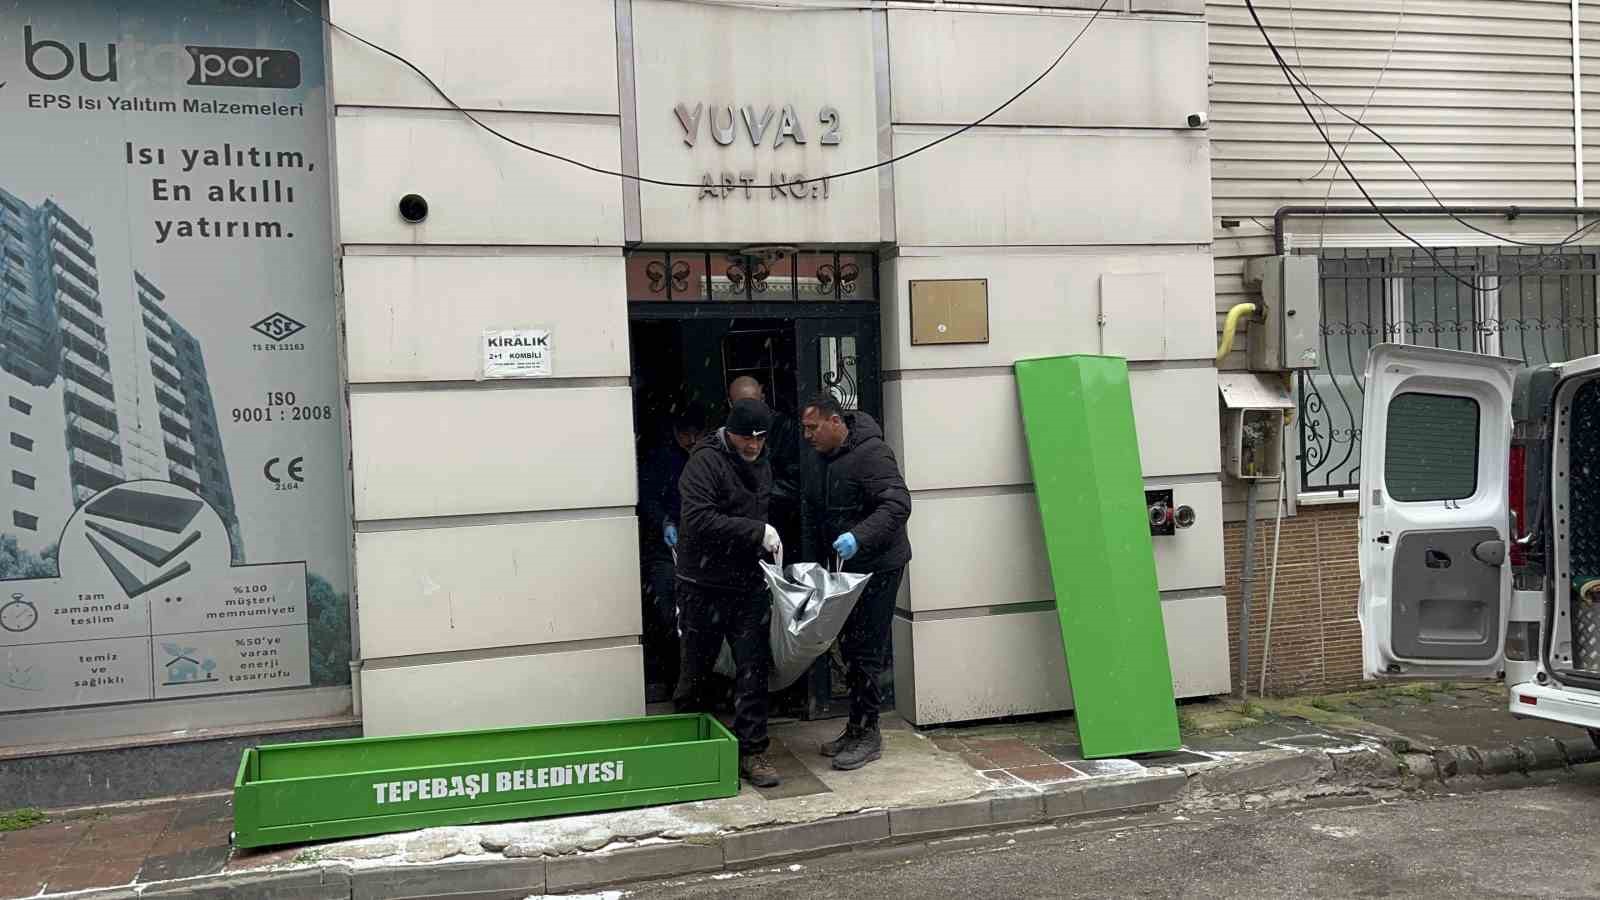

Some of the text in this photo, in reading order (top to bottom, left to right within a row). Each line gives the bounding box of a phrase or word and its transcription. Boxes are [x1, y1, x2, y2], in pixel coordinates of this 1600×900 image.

[28, 94, 304, 117] EPS Isı Yalıtım Malzemeleri
[673, 101, 841, 149] YUVA 2
[126, 142, 316, 172] Isı yalıtım,
[152, 178, 295, 203] En akıllı
[699, 172, 755, 200] APT
[155, 216, 295, 243] yatırım.
[263, 318, 293, 336] TSE
[267, 391, 296, 407] ISO
[232, 408, 273, 423] 9001
[292, 406, 332, 420] 2008
[263, 457, 305, 483] CE
[78, 593, 105, 601] tam
[232, 584, 268, 594] %100
[71, 615, 114, 625] teslim
[79, 652, 117, 663] temiz
[240, 649, 277, 658] varan
[240, 659, 279, 670] enerji
[229, 670, 290, 682] tasarrufu
[373, 773, 489, 804] TEPEBAŞI
